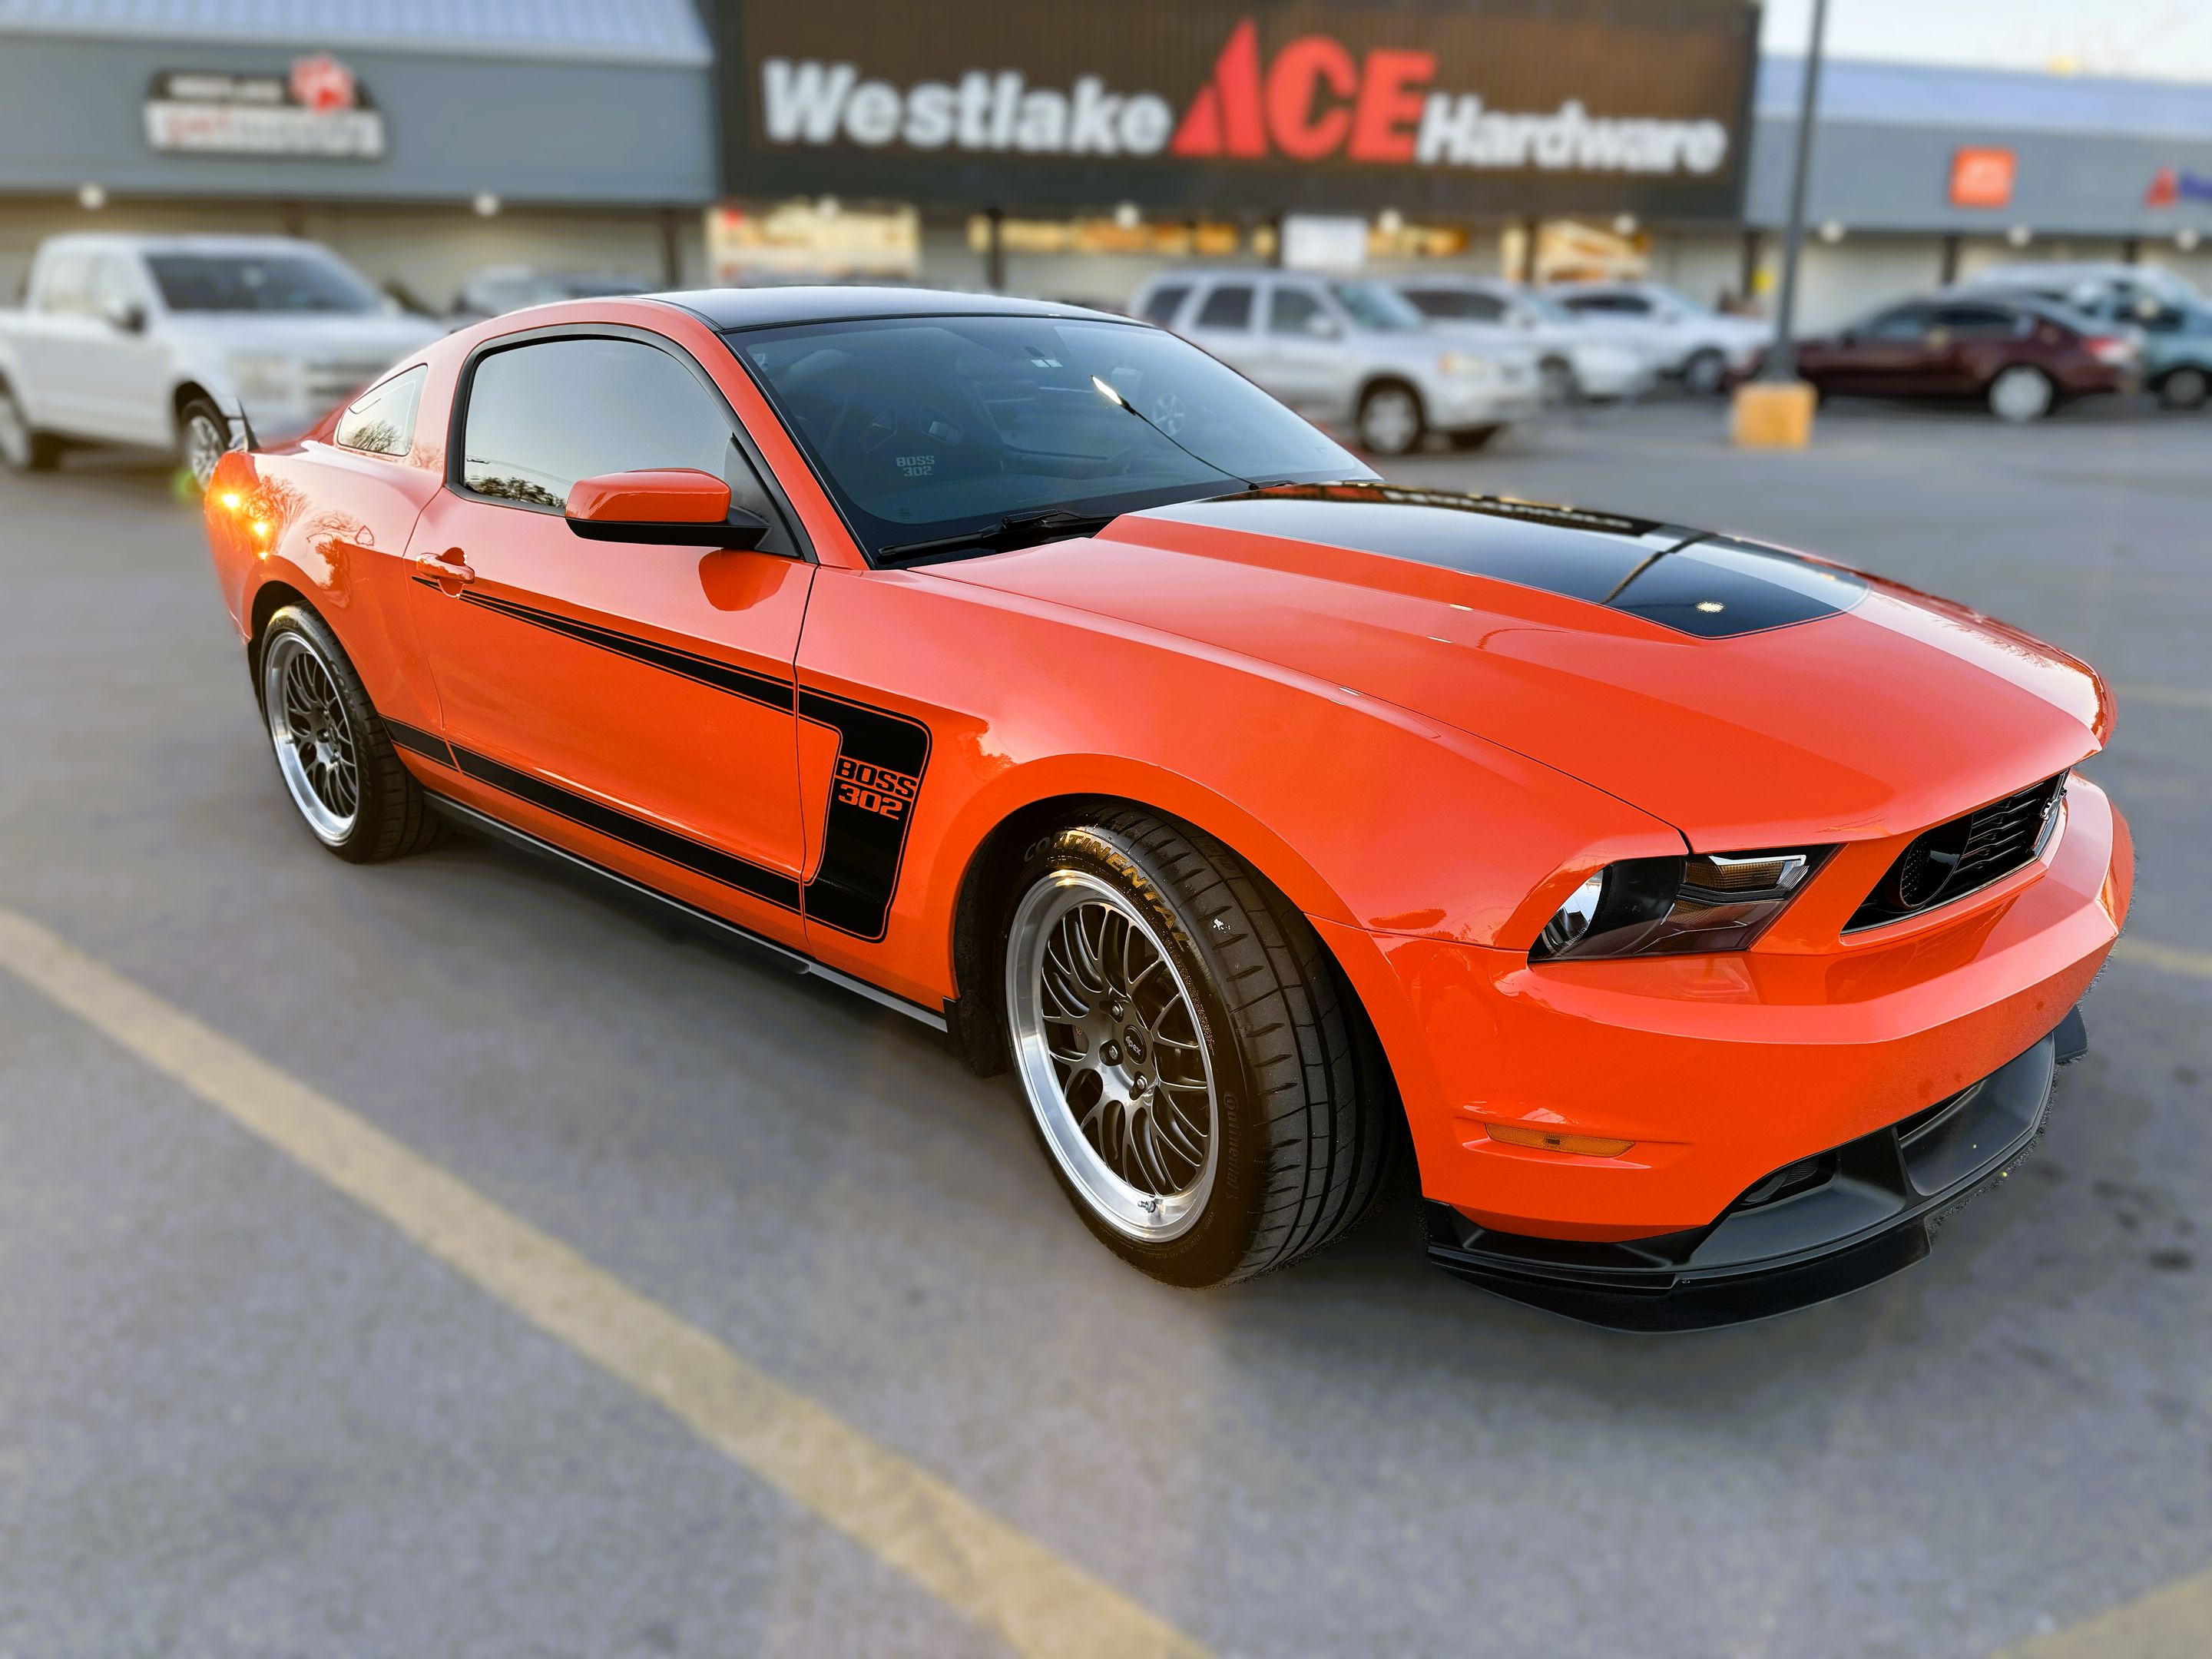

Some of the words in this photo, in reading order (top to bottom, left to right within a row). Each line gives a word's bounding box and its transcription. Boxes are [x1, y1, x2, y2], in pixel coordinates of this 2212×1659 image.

[762, 58, 1173, 156] Westlake
[1171, 17, 1436, 163] ACE
[1416, 94, 1728, 174] Hardware
[896, 455, 935, 467] BOSS
[903, 466, 933, 476] 302
[836, 757, 917, 799] BOSS
[839, 783, 902, 820] 302
